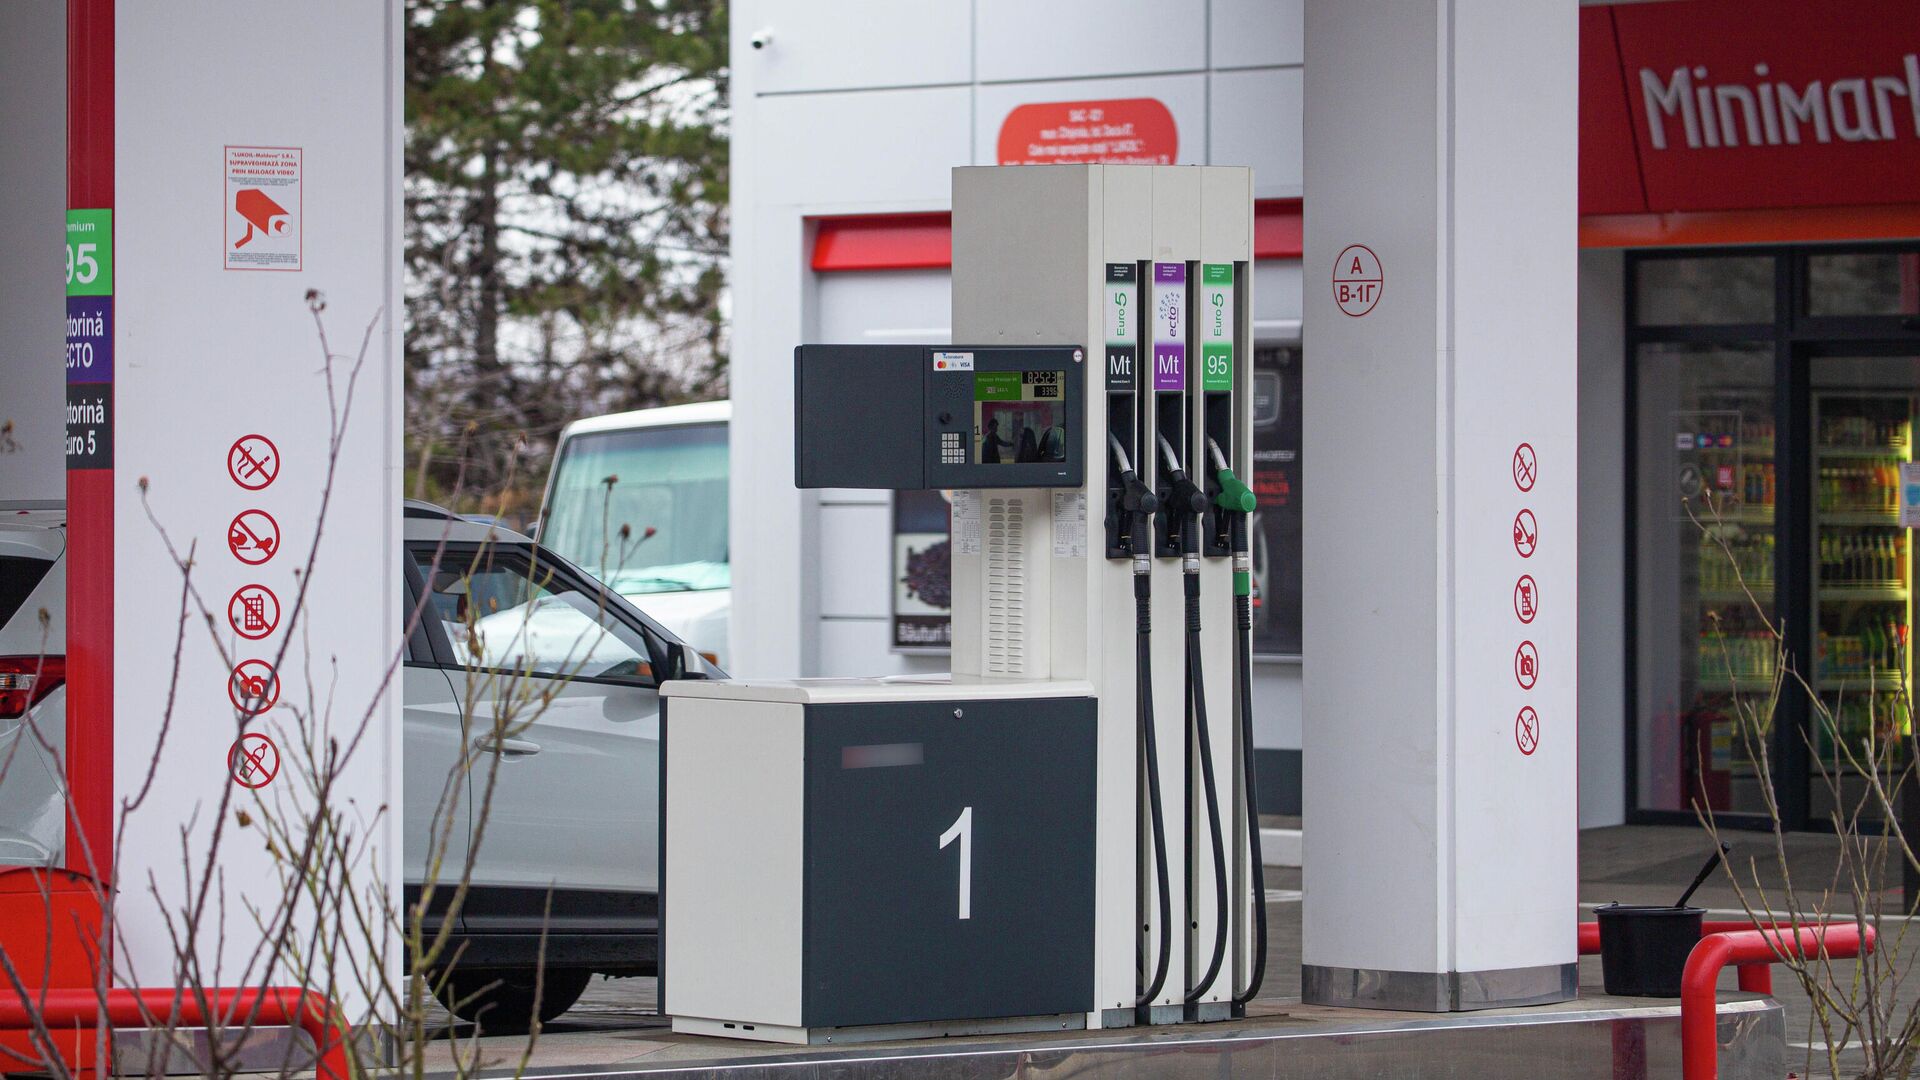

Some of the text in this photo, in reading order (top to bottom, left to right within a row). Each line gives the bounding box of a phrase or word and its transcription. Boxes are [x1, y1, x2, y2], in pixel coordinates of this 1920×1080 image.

[280, 160, 298, 168] ZONA
[1168, 306, 1177, 337] ecto
[1110, 355, 1131, 375] Mt
[1159, 354, 1180, 375] Mt
[1207, 355, 1228, 375] 95
[975, 425, 981, 436] 1
[87, 430, 96, 455] 5
[939, 806, 973, 920] 1
